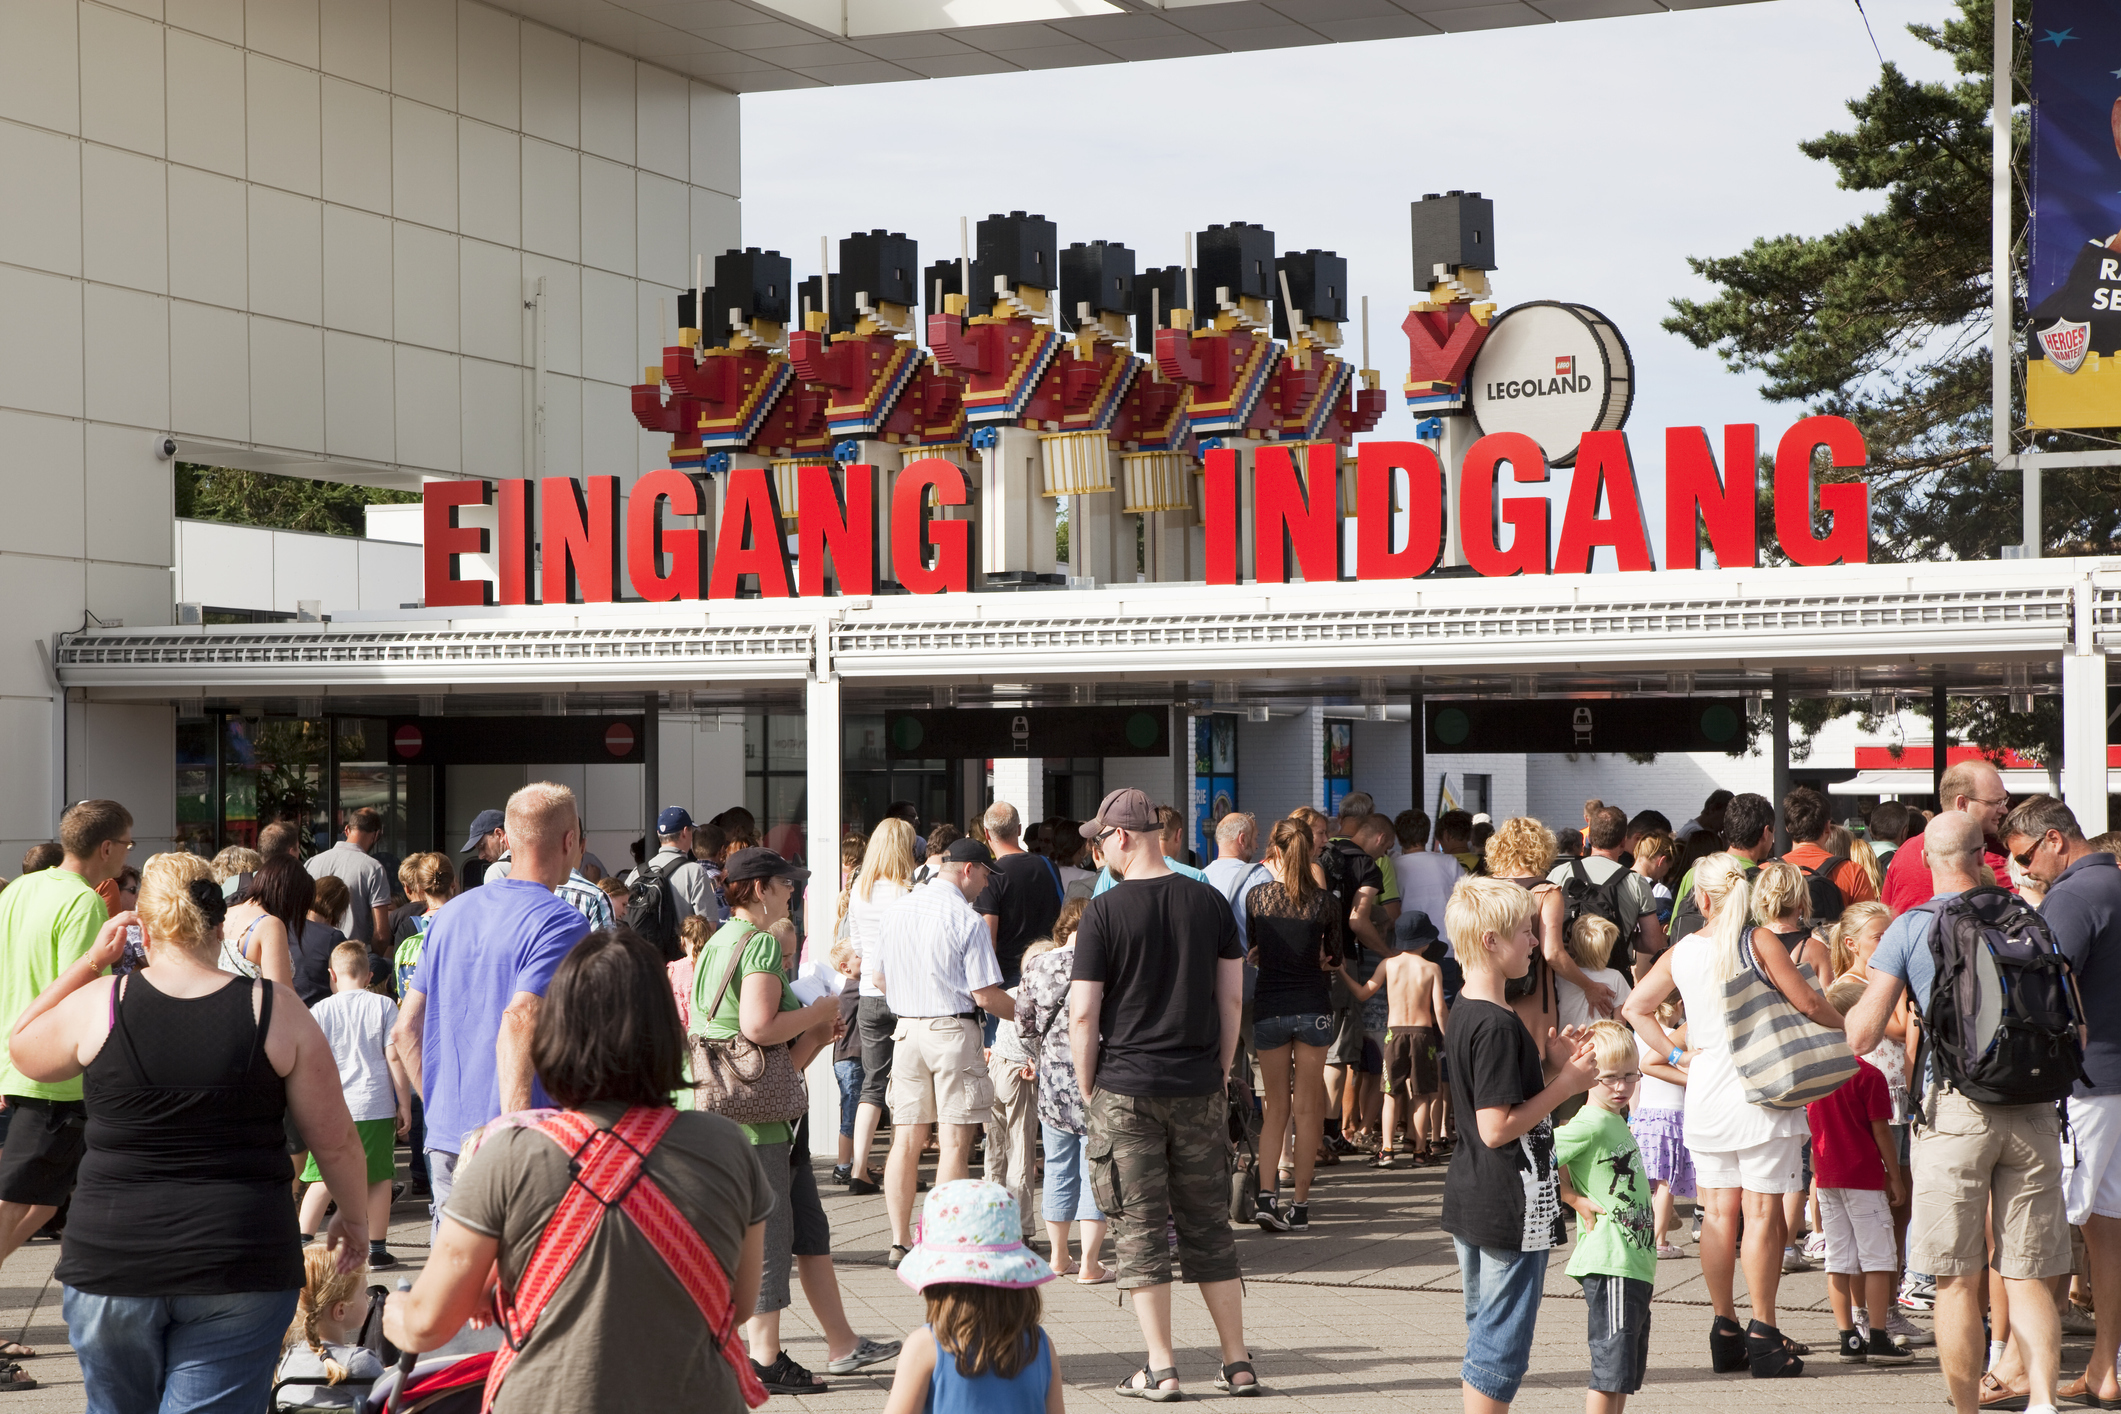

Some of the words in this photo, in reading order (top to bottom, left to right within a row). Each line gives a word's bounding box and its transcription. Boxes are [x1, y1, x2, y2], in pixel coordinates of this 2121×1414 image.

[2100, 258, 2121, 281] R
[2044, 327, 2085, 351] HEROES
[2051, 345, 2083, 361] WANTED
[1557, 361, 1570, 369] LEGO
[1487, 355, 1591, 401] LEGOLAND
[424, 458, 972, 607] EINGANG
[1205, 415, 1871, 585] INDGANG
